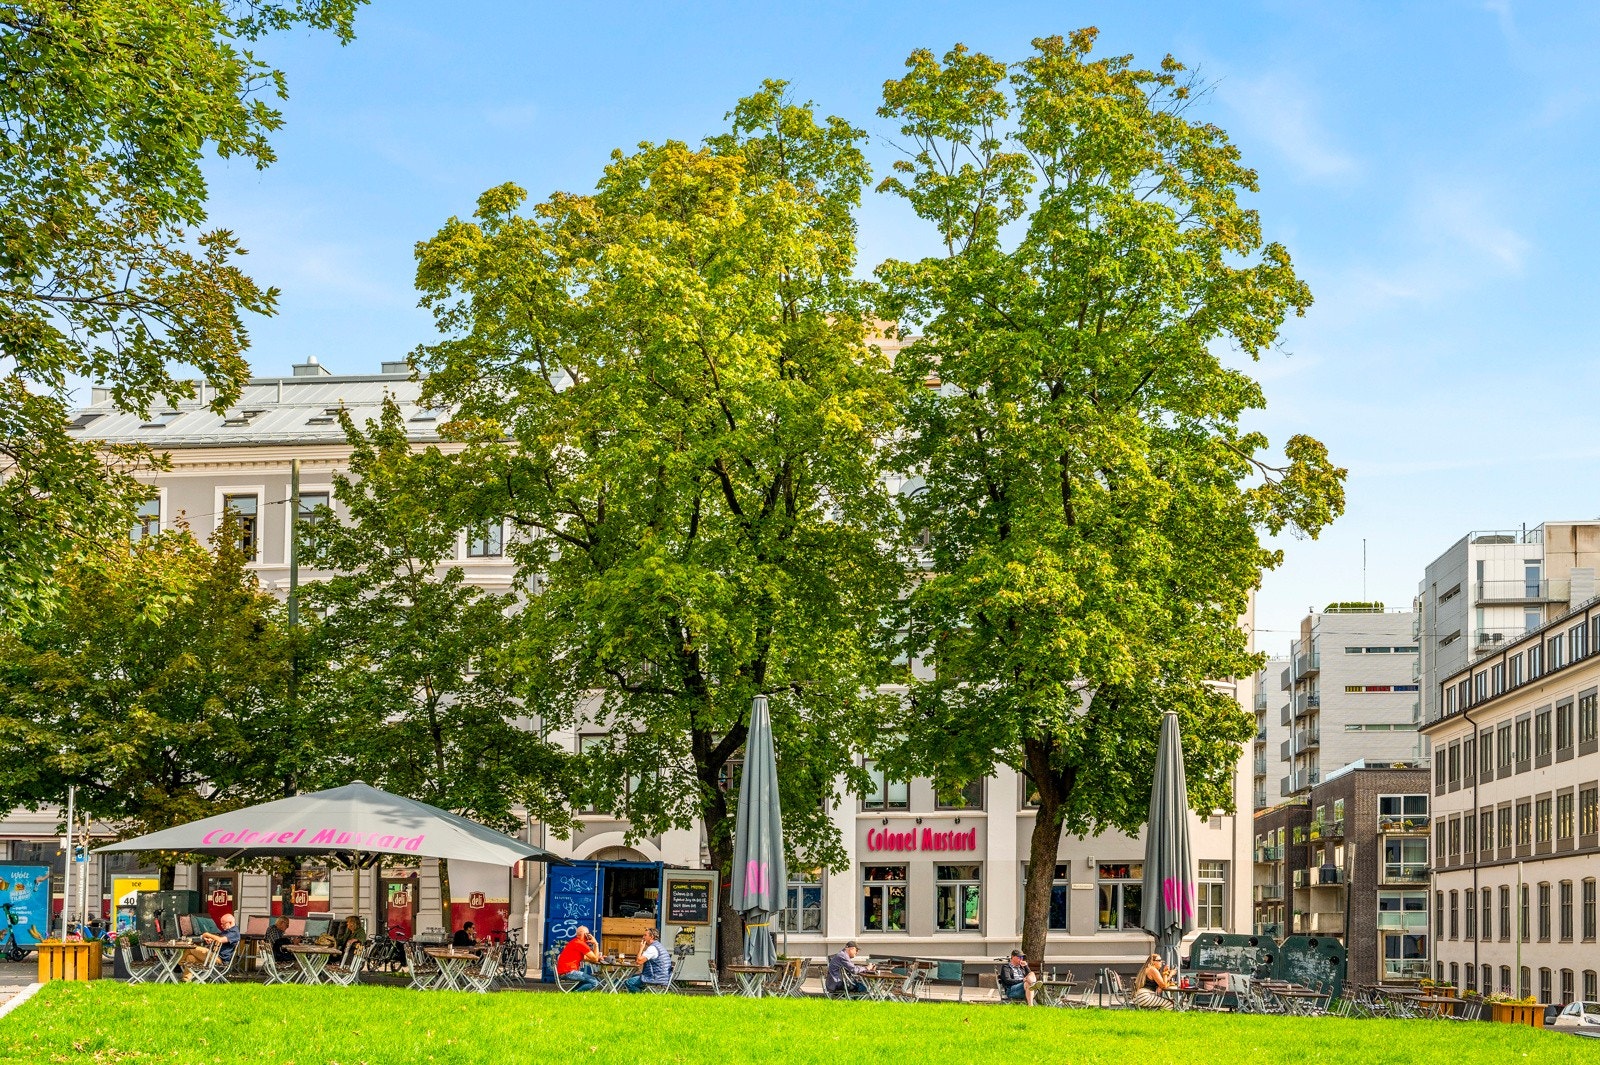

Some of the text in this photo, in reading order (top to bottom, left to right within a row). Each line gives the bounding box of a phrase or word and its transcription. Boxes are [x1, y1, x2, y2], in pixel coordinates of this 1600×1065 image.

[202, 828, 425, 851] Colonel Mustard
[867, 827, 976, 851] Colonel Mustard
[123, 897, 135, 906] 40
